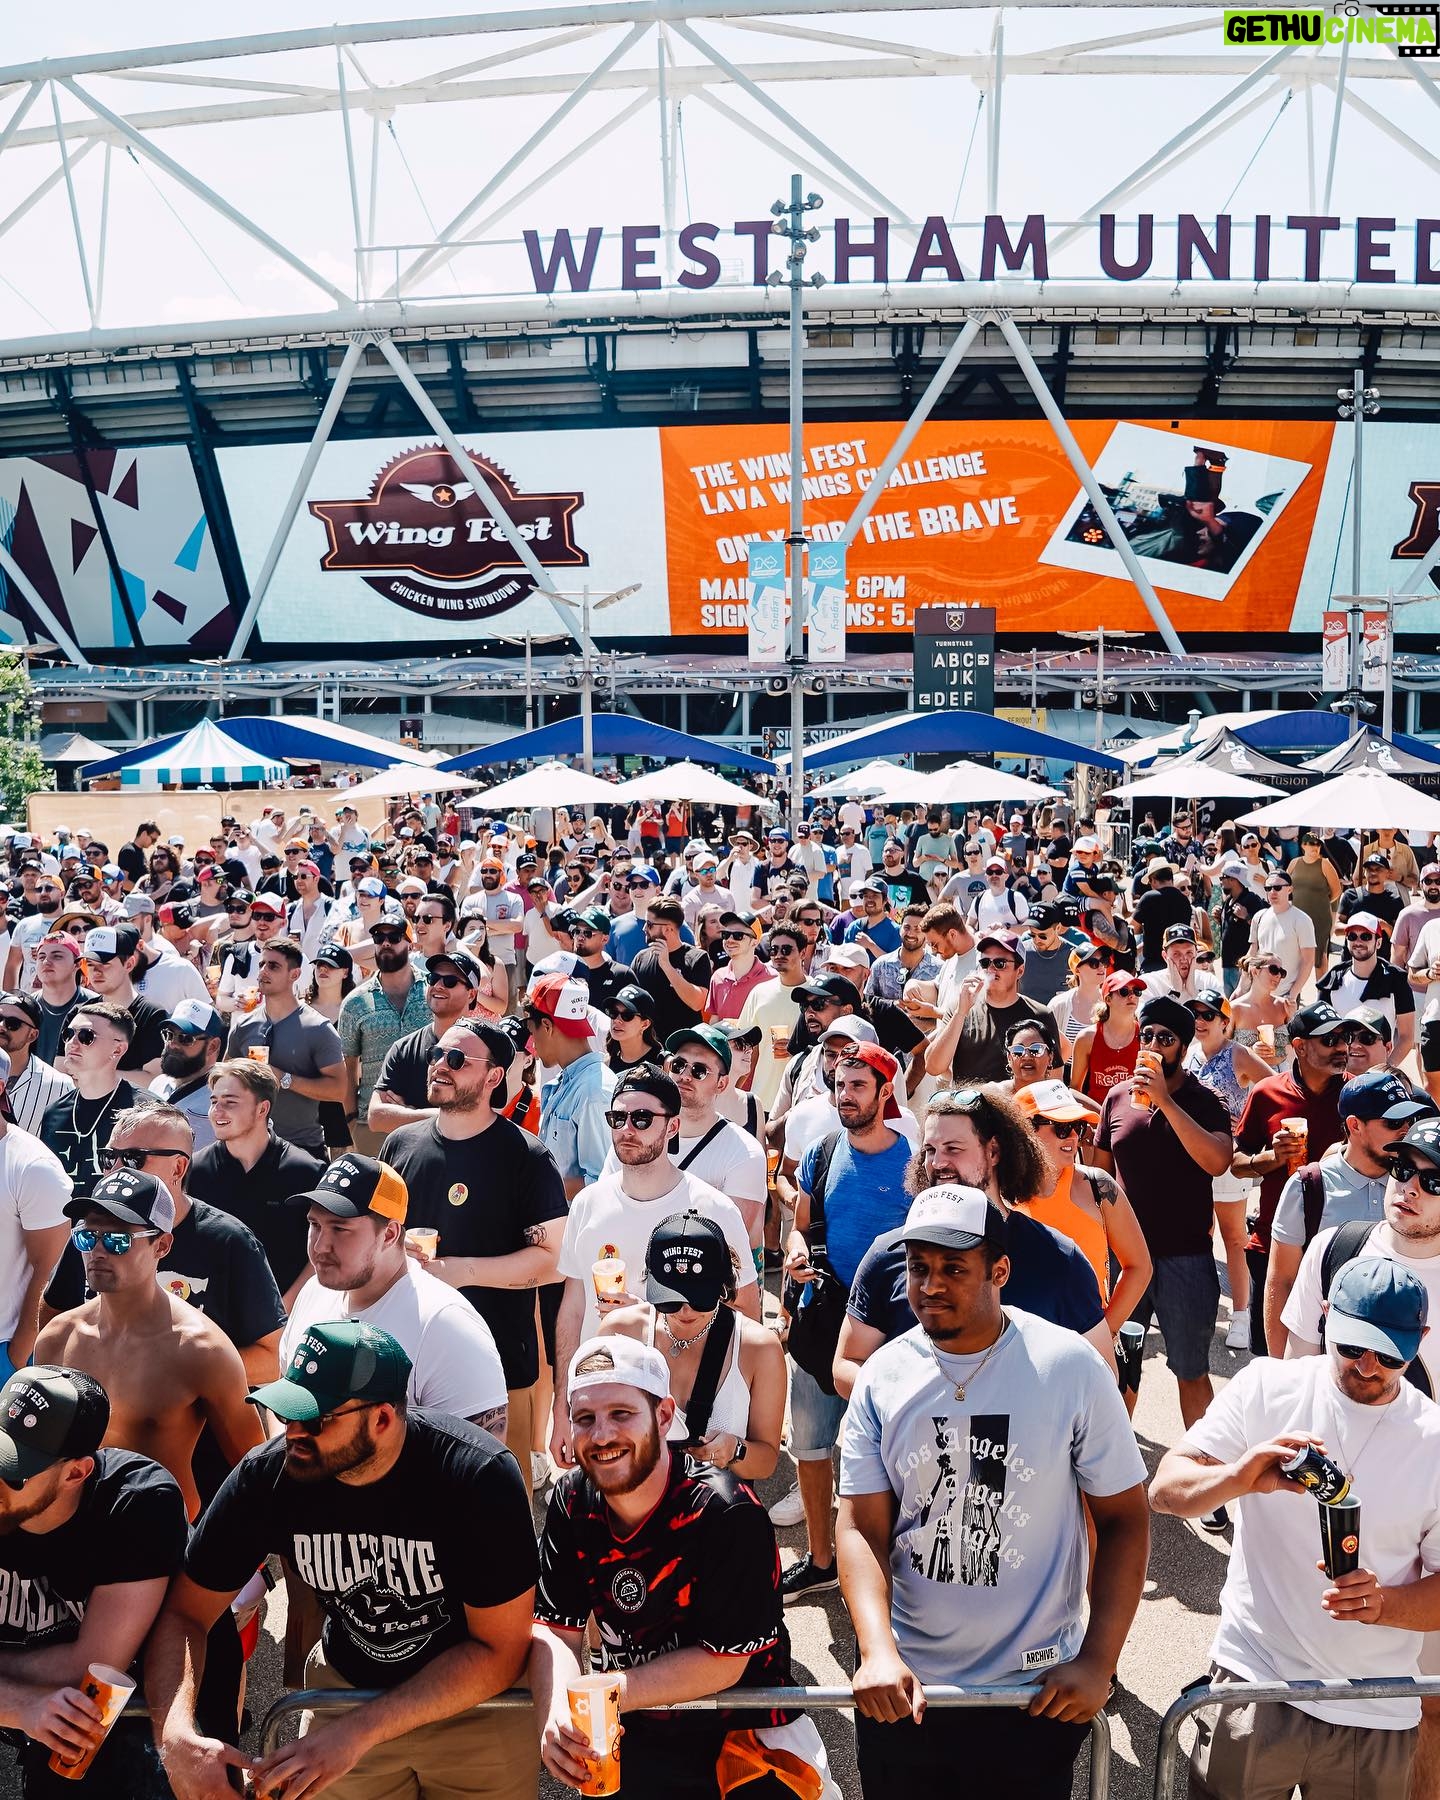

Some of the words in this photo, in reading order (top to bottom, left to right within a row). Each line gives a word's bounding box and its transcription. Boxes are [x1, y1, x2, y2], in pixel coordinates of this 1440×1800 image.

[523, 220, 774, 293] WEST
[834, 215, 1049, 283] HAM
[690, 462, 738, 489] THE
[810, 440, 867, 471] FEST
[699, 486, 767, 515] LAVA
[862, 511, 914, 544] THE
[918, 496, 1020, 536] BRAVE
[344, 521, 455, 547] Wing
[389, 580, 434, 608] CHICKEN
[436, 597, 464, 611] WING
[466, 580, 522, 610] SHOWDOWN
[857, 576, 905, 598] 6PM
[1271, 775, 1308, 785] fusion
[118, 1171, 140, 1186] FEST
[339, 1160, 360, 1176] FEST
[941, 1191, 964, 1204] FEST
[662, 1246, 682, 1259] WING
[683, 1246, 704, 1259] FEST
[306, 1335, 328, 1356] FEST
[9, 1382, 29, 1395] WING
[26, 1387, 50, 1411] FEST
[942, 1426, 1038, 1483] Angeles
[1026, 1647, 1055, 1664] ARCHIVE
